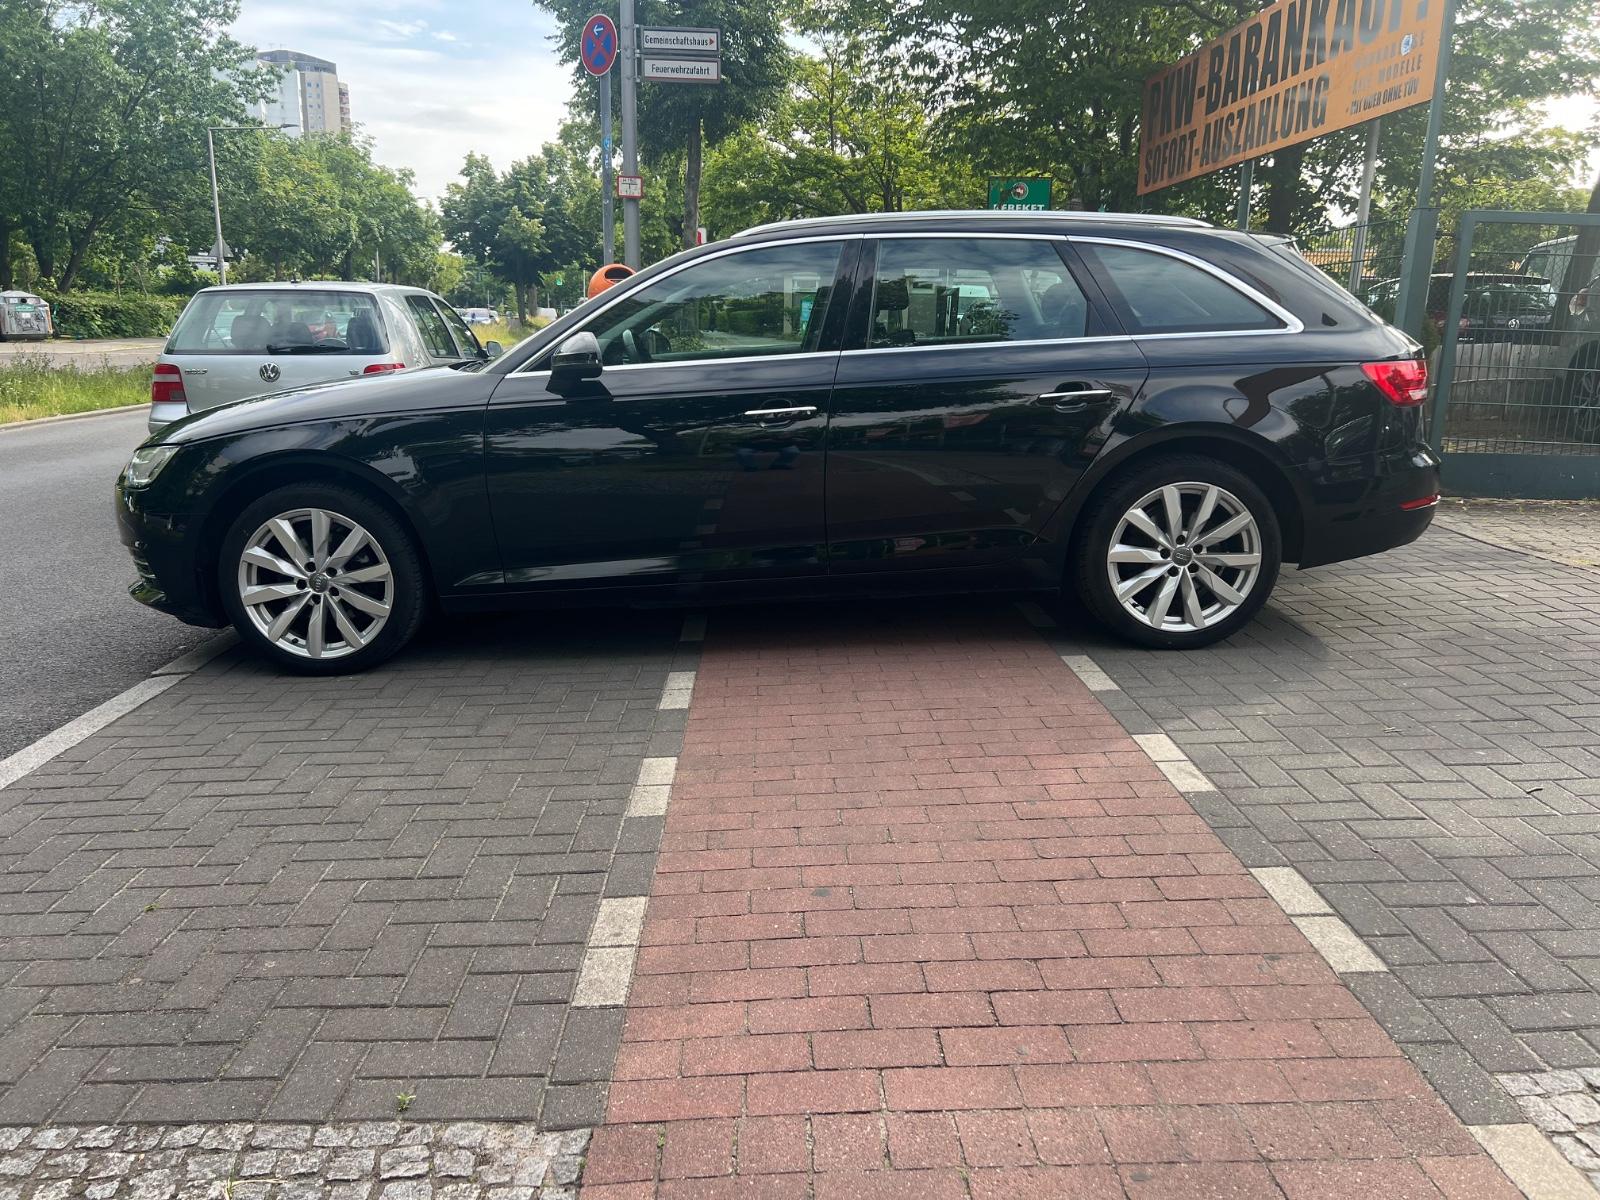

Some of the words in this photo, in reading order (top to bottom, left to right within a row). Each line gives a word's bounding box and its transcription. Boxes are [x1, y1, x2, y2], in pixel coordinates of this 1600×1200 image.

[645, 34, 708, 46] Gemeinschaftshaus
[651, 63, 710, 75] Feuerwehrzufahrt
[1147, 0, 1429, 143] PKW-BARANKAU
[1144, 73, 1330, 187] SOFORT-AUSZAHLUNG
